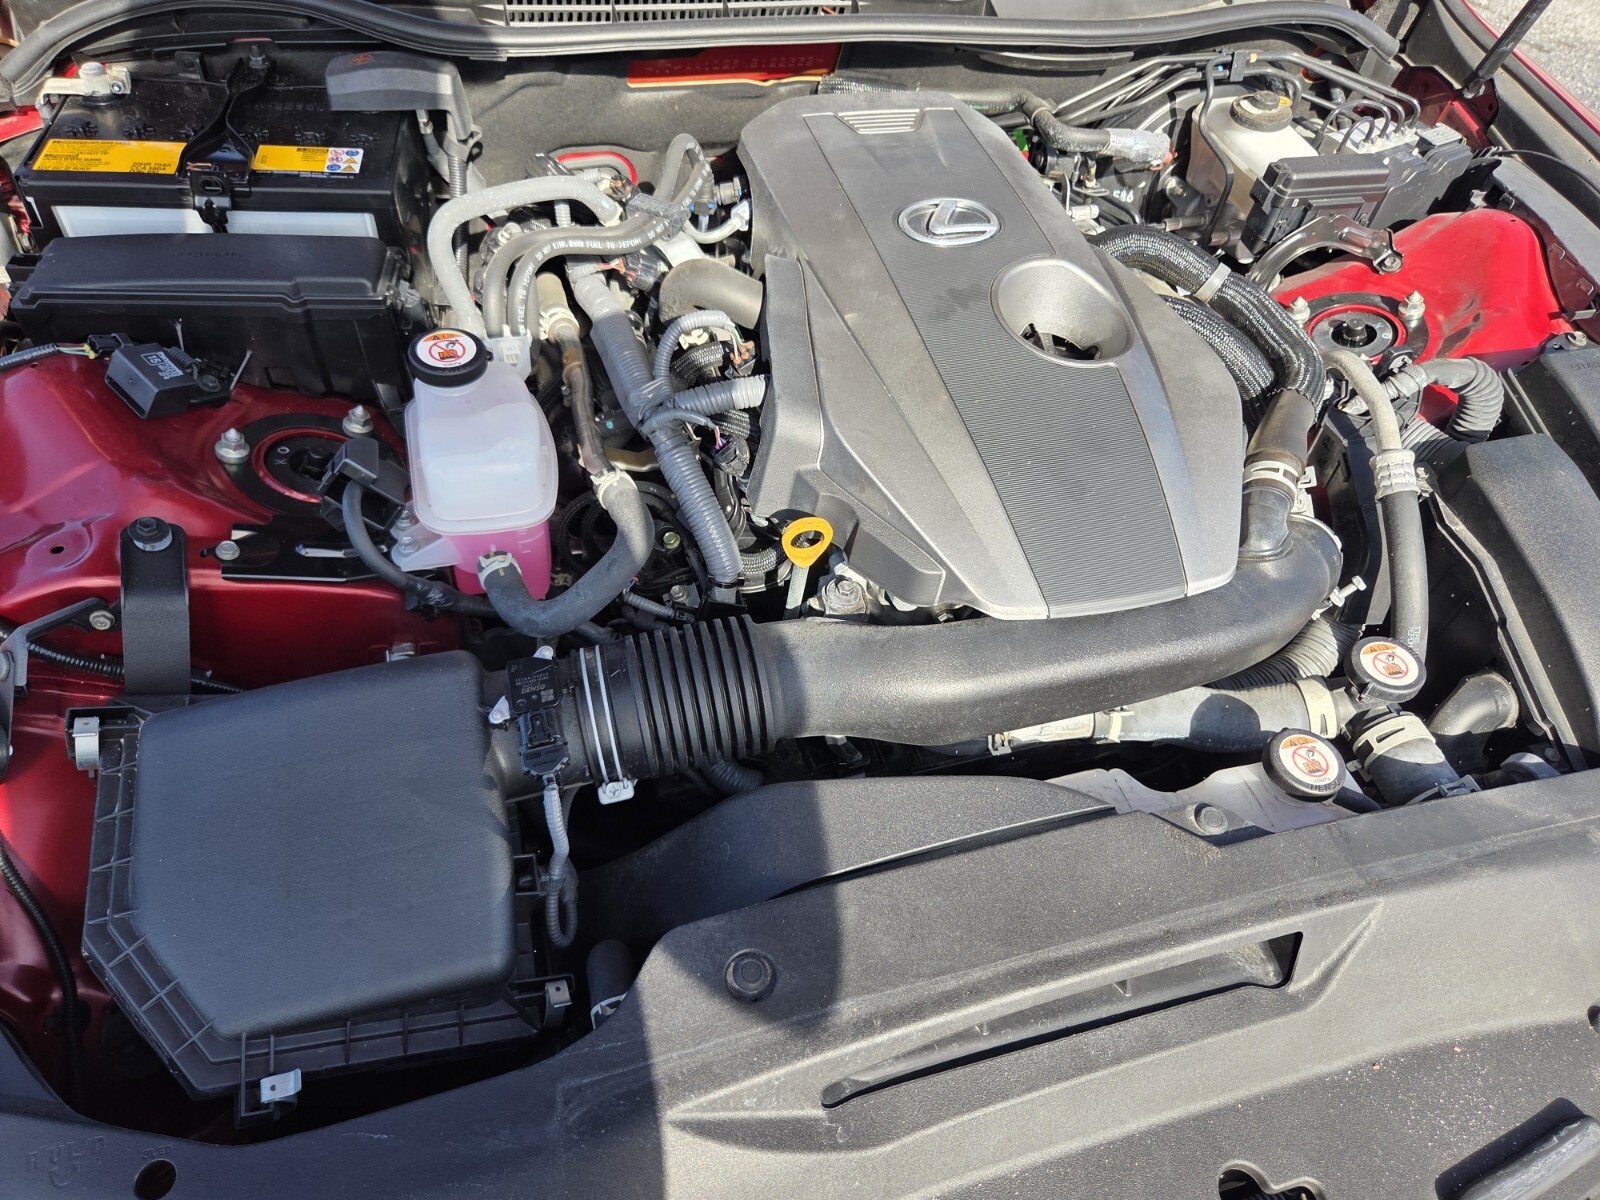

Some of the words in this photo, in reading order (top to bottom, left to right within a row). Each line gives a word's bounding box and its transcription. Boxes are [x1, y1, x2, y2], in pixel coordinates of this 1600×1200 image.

[586, 240, 603, 249] FUEL
[521, 684, 546, 694] DENSO
[1308, 779, 1341, 792] DENSO
